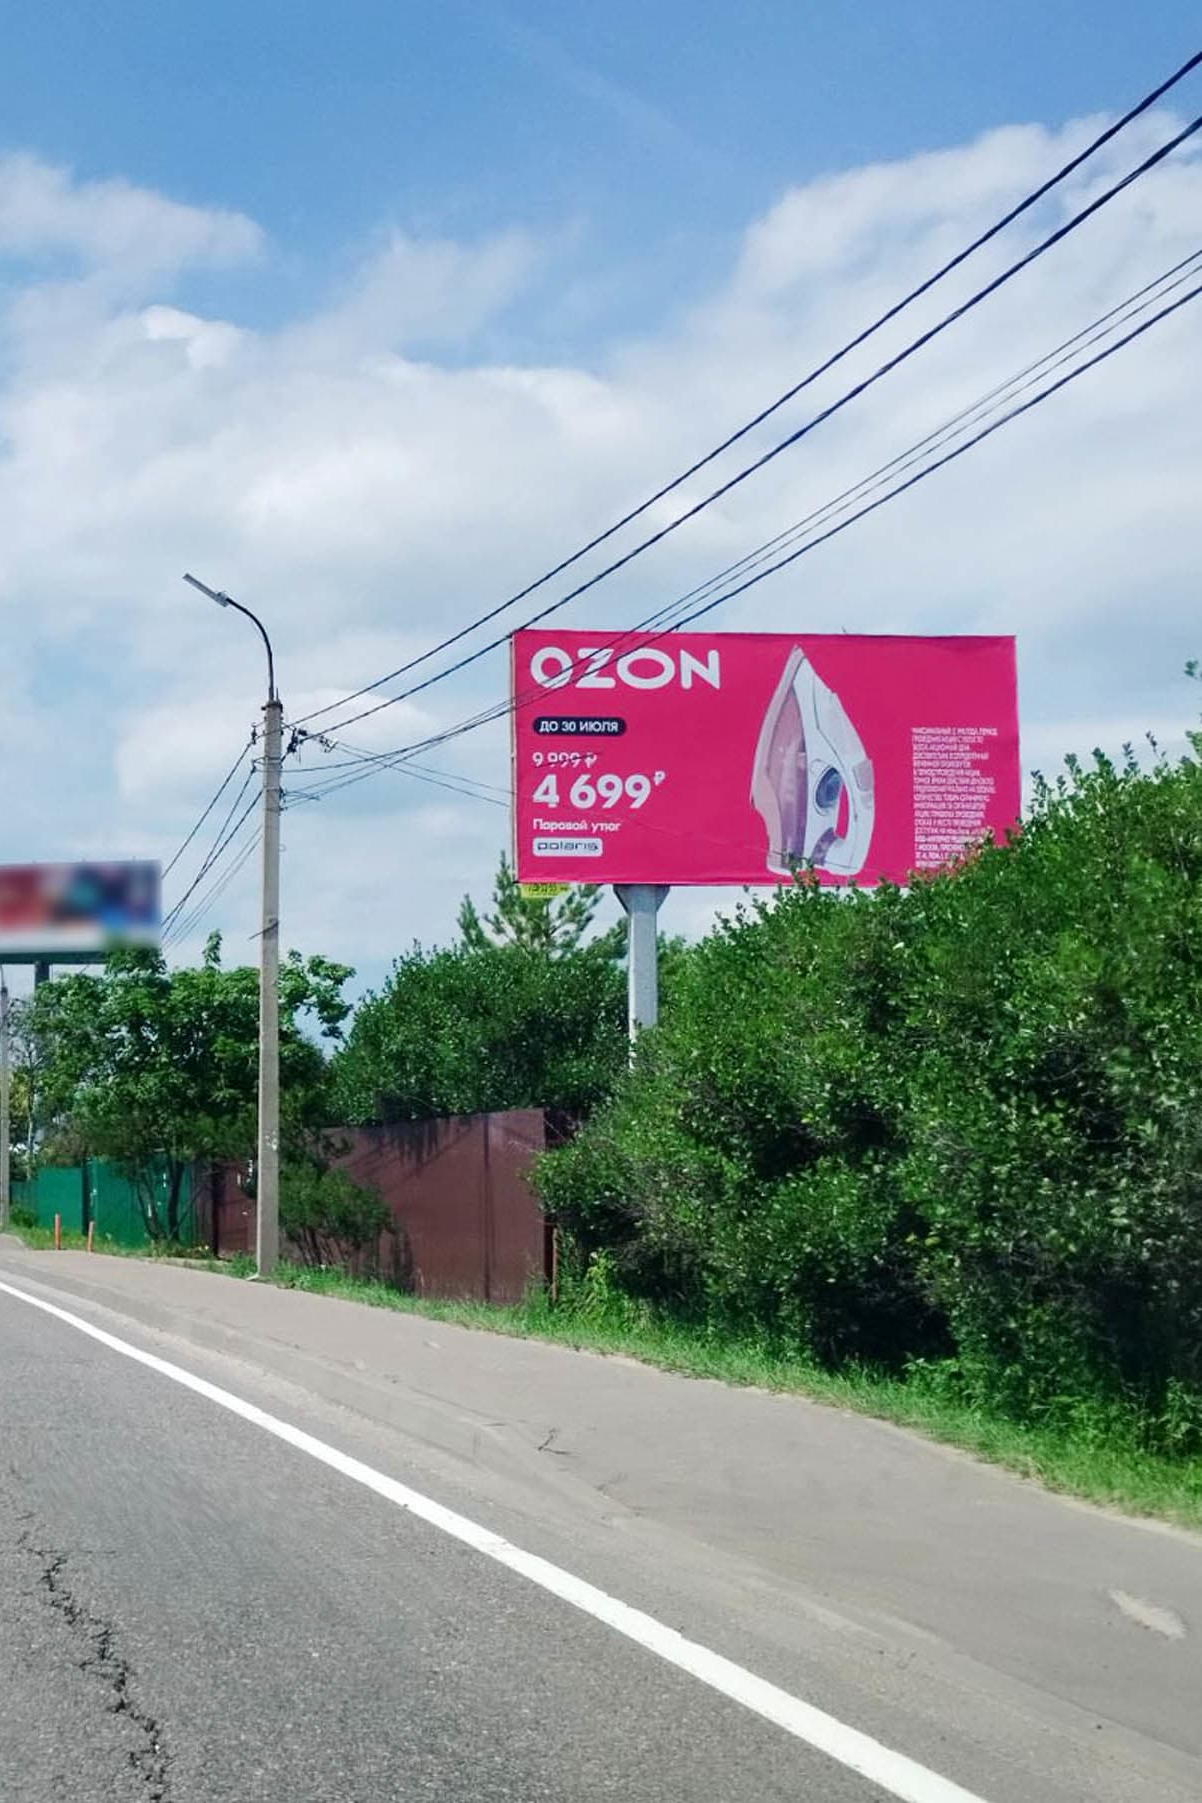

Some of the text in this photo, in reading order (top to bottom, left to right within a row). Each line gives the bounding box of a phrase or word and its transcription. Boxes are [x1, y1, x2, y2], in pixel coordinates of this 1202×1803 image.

[530, 646, 720, 690] OZON
[539, 719, 619, 732] ДО 30 ИЮЛЯ
[532, 818, 621, 834] Паровой утюг
[537, 840, 599, 851] polaris
